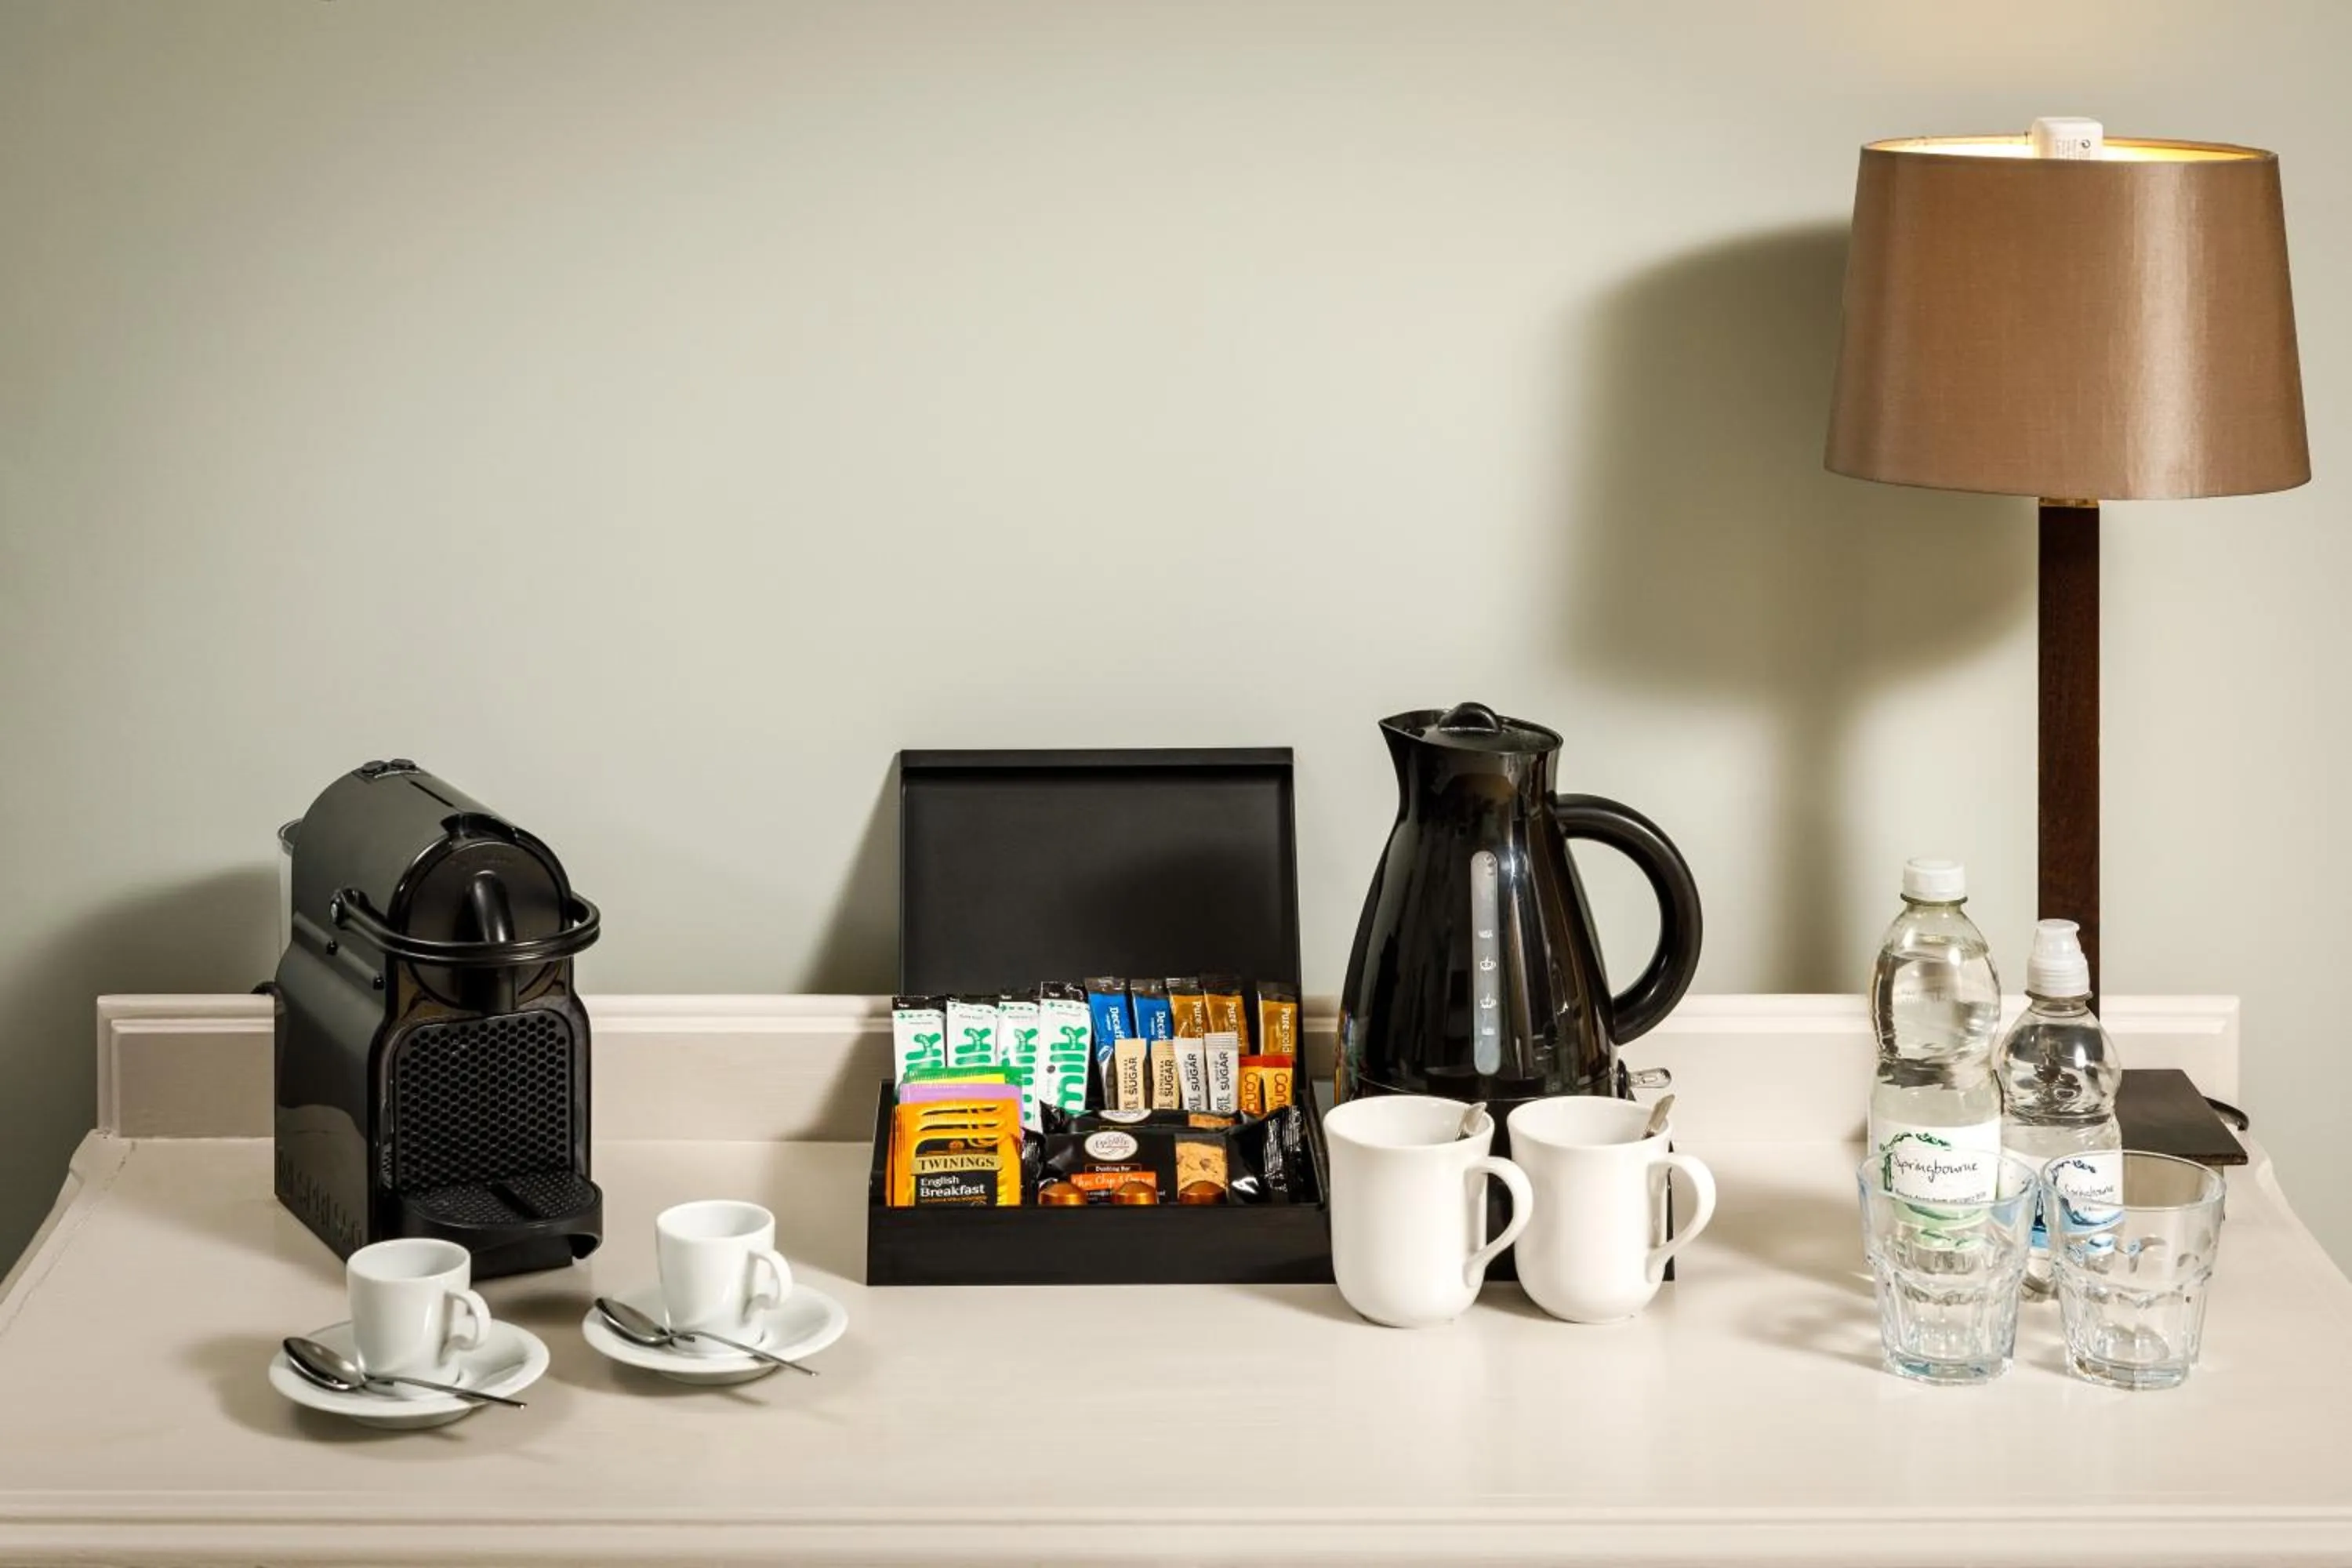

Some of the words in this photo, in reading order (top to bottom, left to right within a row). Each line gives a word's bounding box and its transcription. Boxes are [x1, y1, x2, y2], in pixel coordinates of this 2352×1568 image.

[1282, 1007, 1291, 1030] Pure
[1050, 1026, 1087, 1114] milk
[1128, 1056, 1138, 1095] SUGAR
[1164, 1058, 1174, 1098] SUGAR
[1190, 1053, 1200, 1092] SUGAR
[1219, 1051, 1229, 1091] SUGAR
[919, 1157, 995, 1171] TWININGS
[920, 1176, 960, 1187] English
[1893, 1152, 1979, 1183] Springbourne
[920, 1185, 985, 1197] Breakfast
